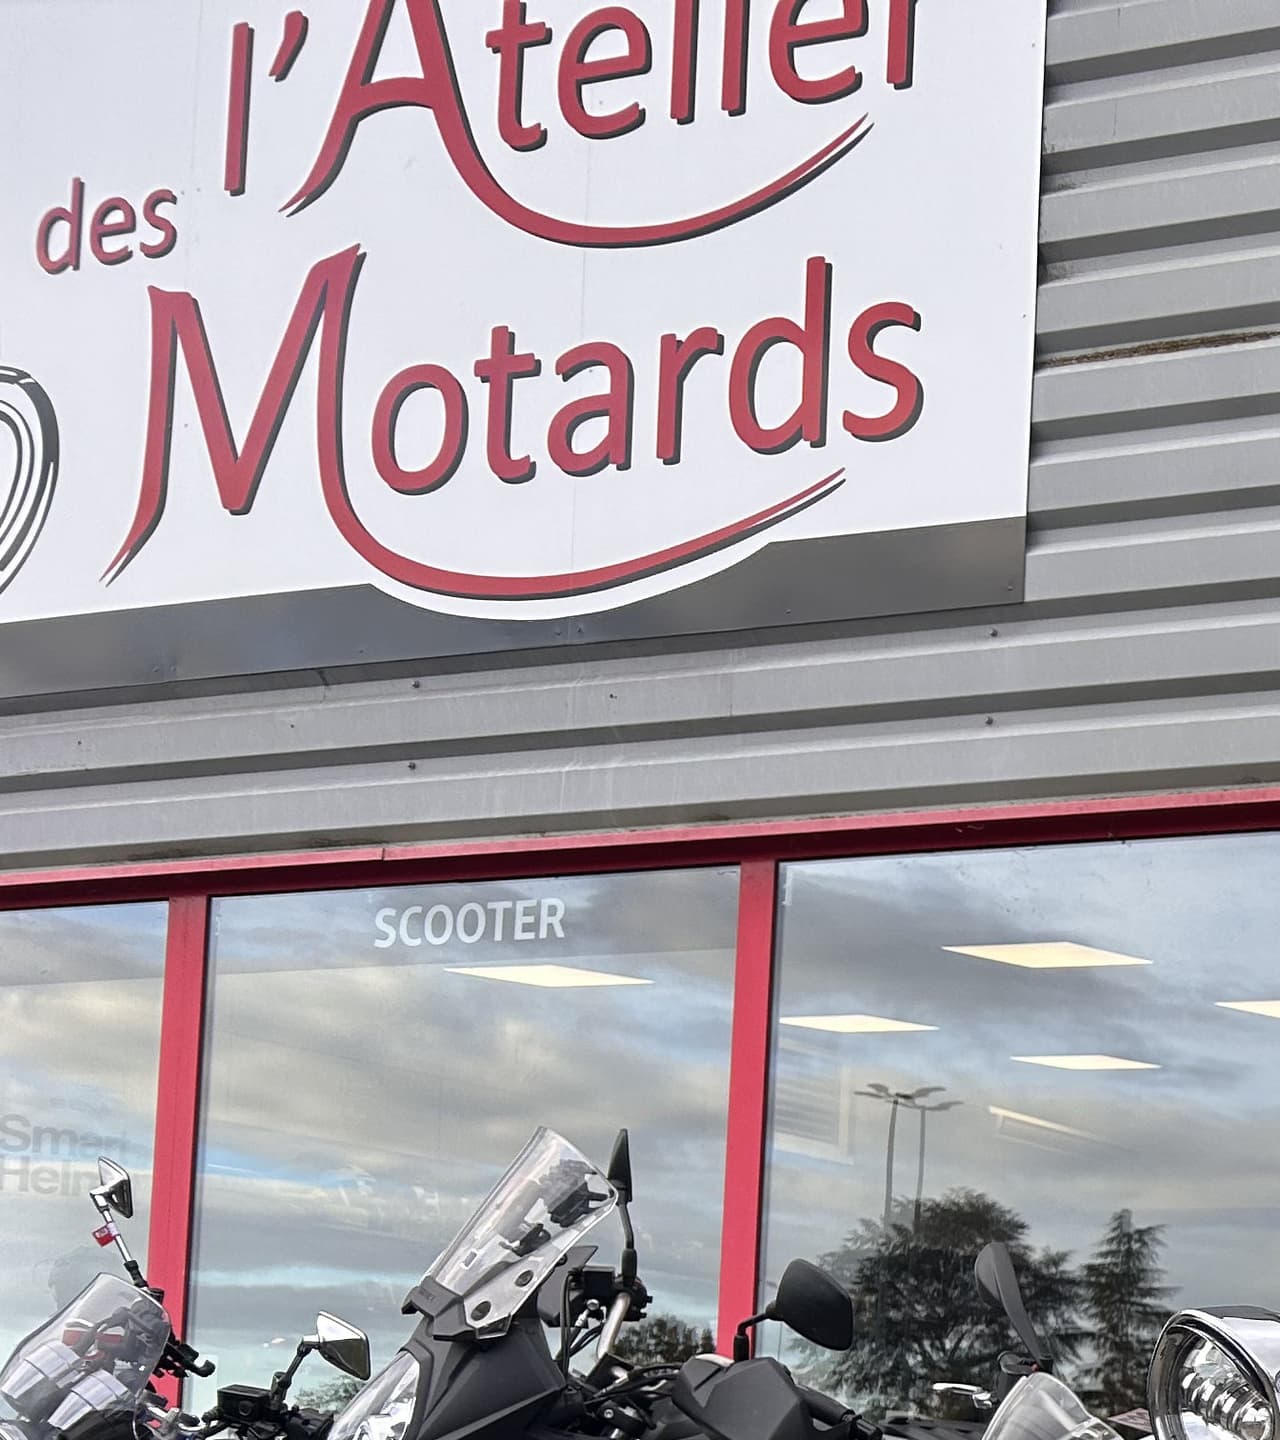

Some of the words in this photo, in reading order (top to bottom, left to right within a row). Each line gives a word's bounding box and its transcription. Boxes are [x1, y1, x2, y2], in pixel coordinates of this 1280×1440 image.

[35, 176, 178, 276] des
[100, 243, 925, 601] Motards
[373, 898, 566, 949] SCOOTER
